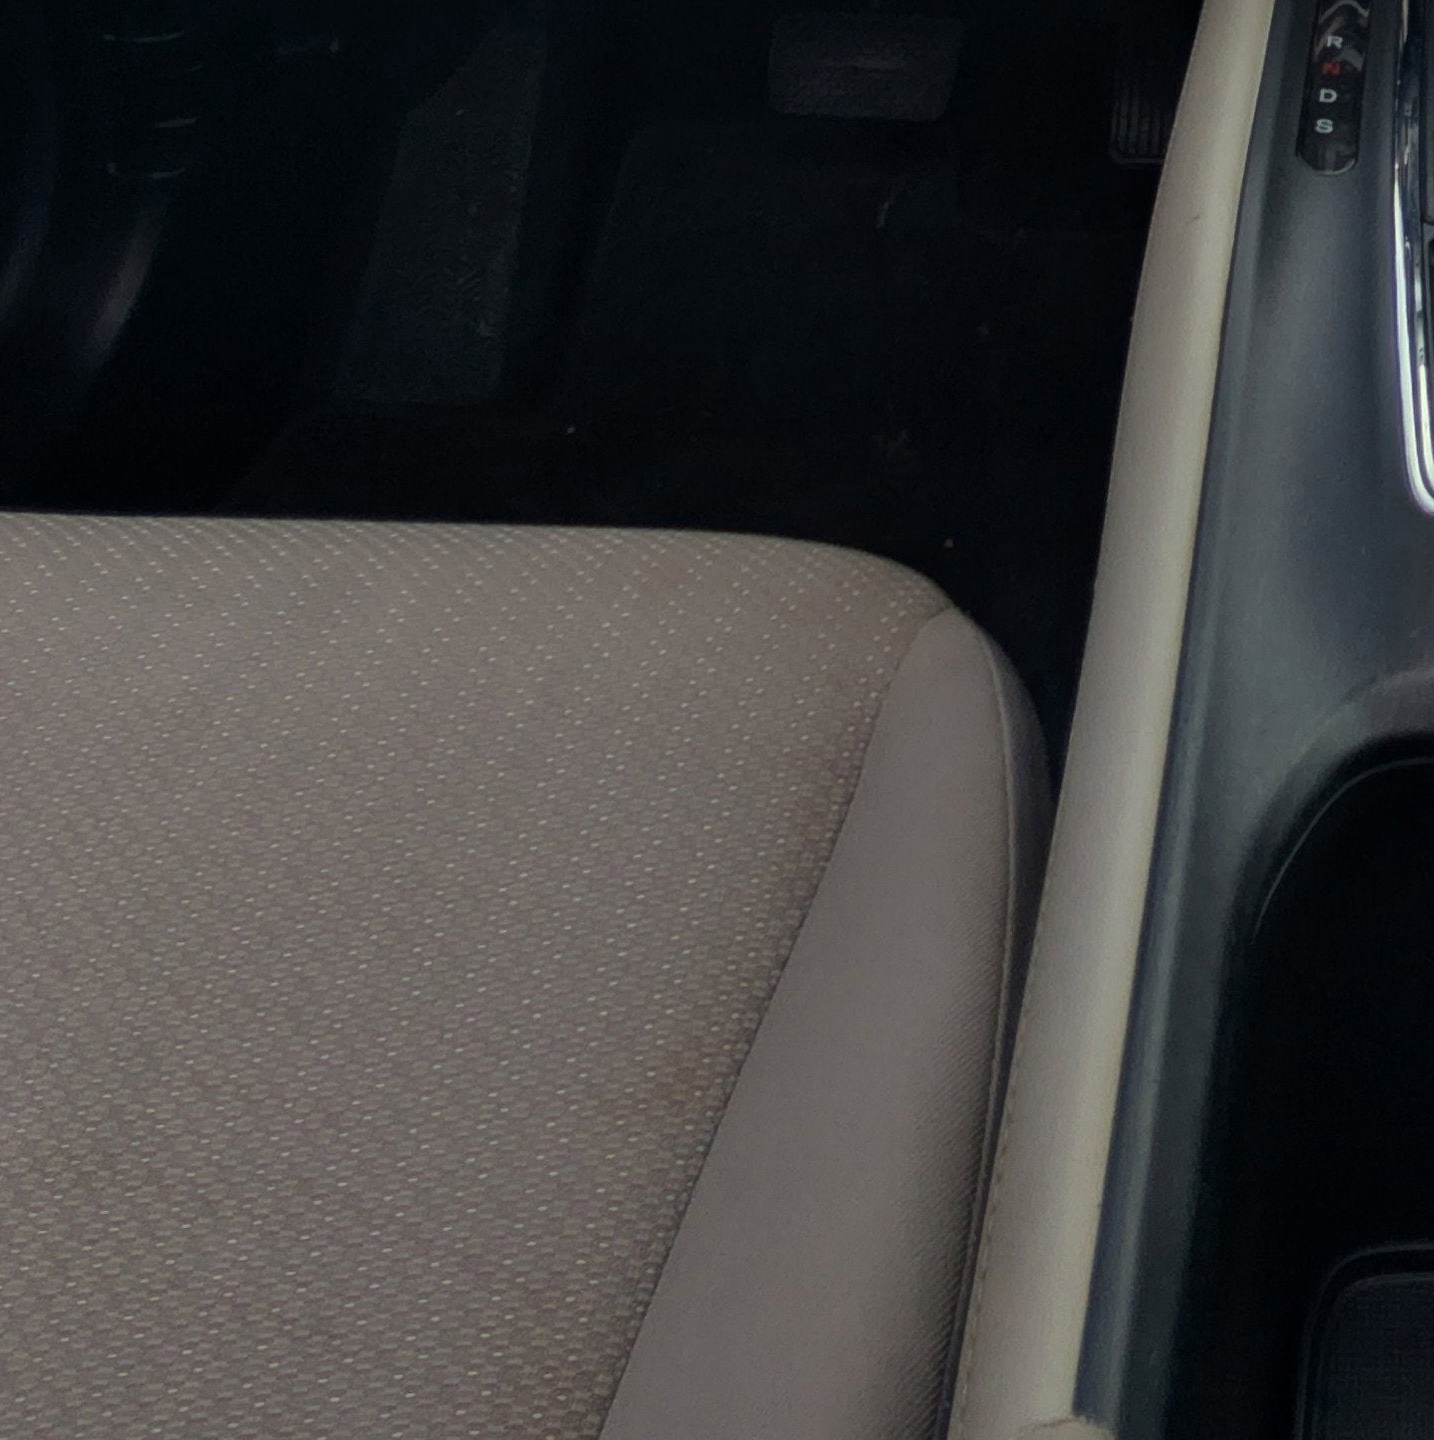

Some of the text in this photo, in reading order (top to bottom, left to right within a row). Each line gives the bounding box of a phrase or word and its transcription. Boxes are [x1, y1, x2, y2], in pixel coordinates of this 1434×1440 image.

[1326, 35, 1344, 50] R
[1319, 88, 1338, 104] D
[1315, 118, 1334, 135] S
